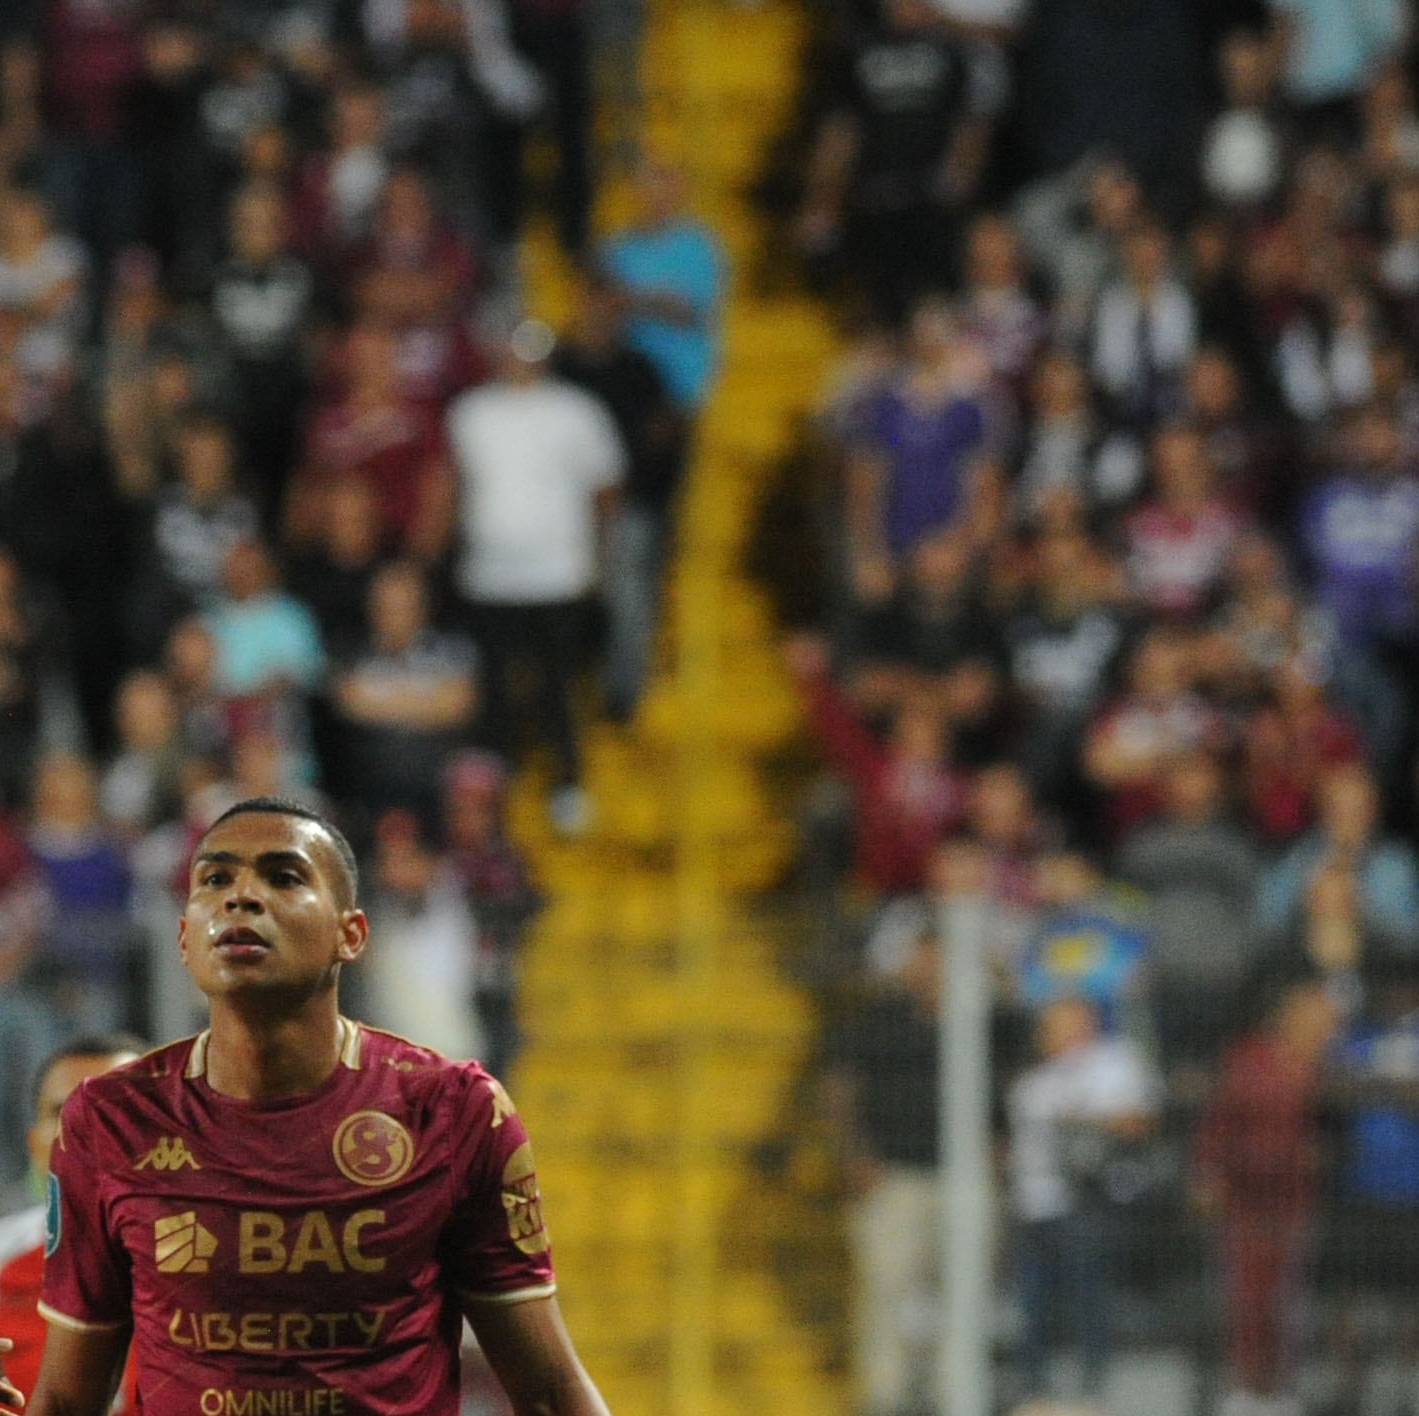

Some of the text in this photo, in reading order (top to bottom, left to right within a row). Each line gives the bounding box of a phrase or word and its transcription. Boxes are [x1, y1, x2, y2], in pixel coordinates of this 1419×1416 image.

[239, 1209, 387, 1274] BAC
[169, 1308, 388, 1352] LIBERTY
[200, 1387, 345, 1416] OMNILIFE
